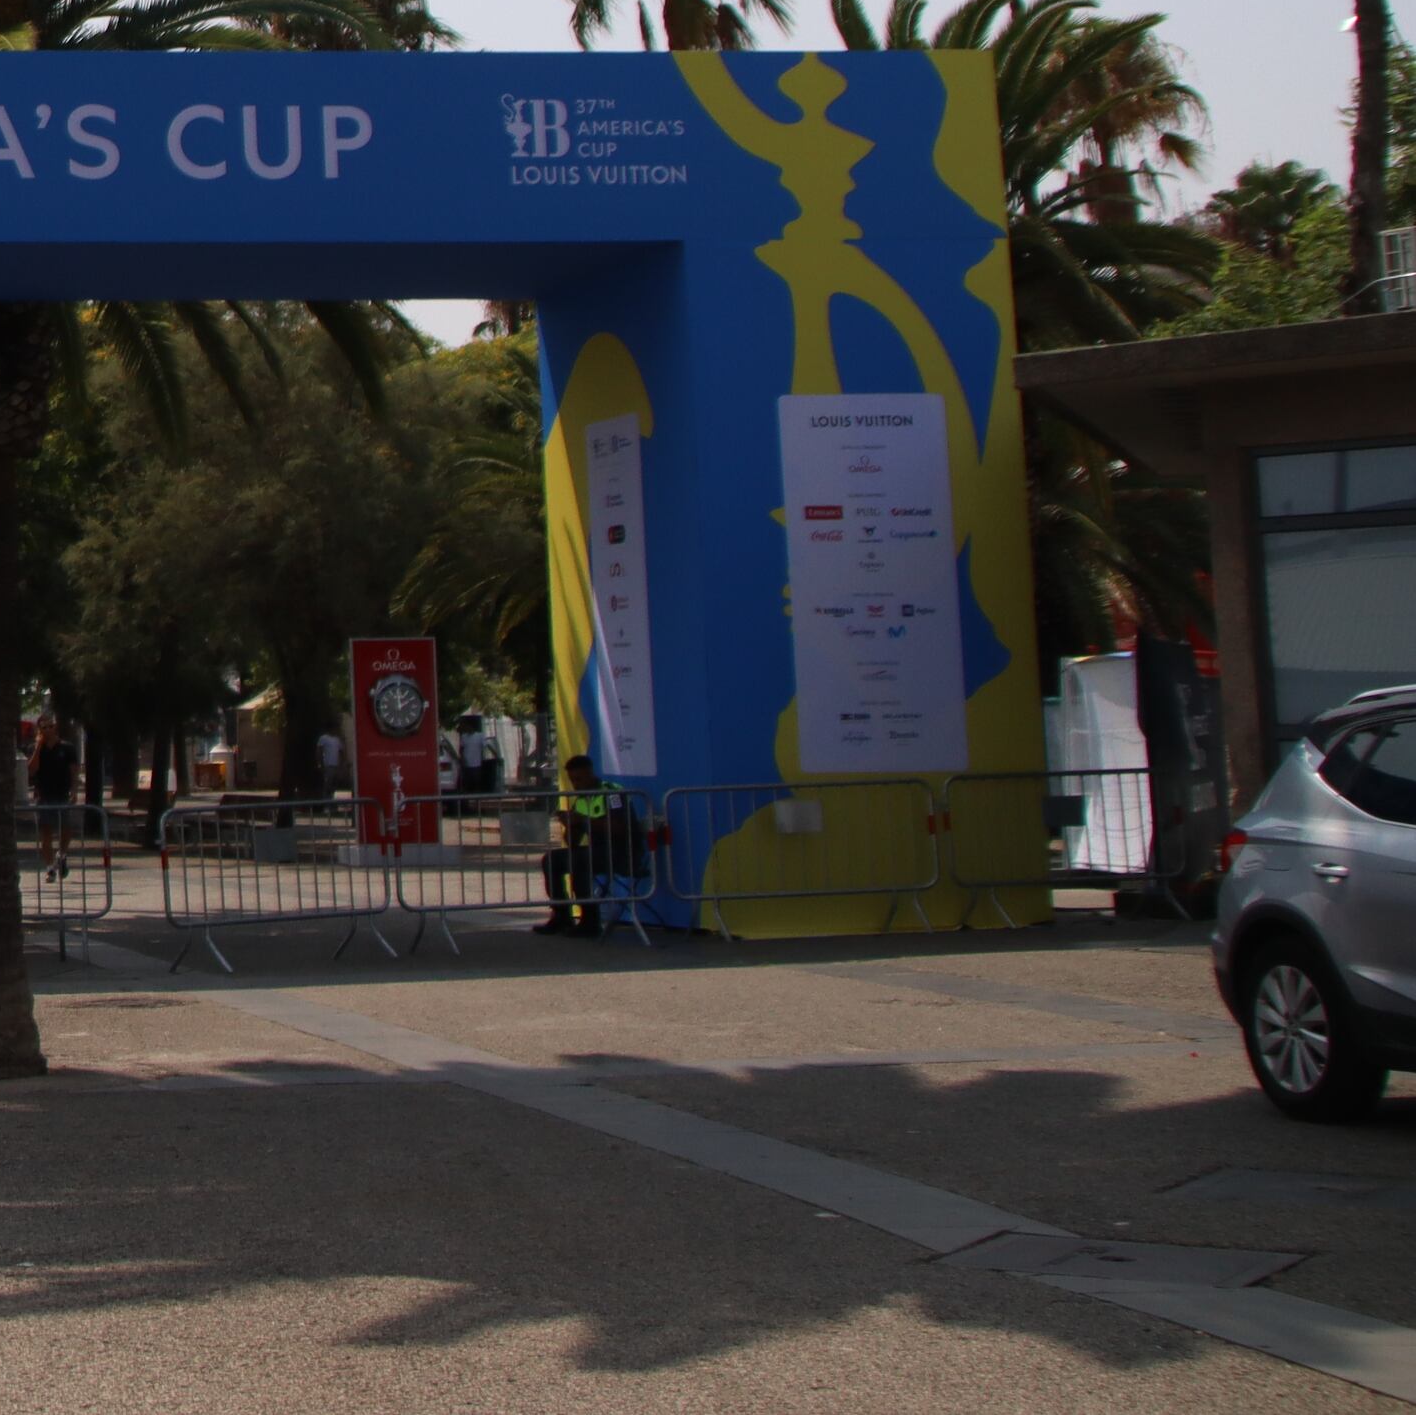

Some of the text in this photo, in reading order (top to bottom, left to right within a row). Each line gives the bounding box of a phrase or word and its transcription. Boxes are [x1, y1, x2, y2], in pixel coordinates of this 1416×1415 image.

[575, 99, 616, 115] 37TH
[576, 120, 685, 136] AMERICA'S
[168, 103, 372, 180] CUP
[577, 142, 618, 158] CUP
[511, 165, 687, 185] LOUIS VUITTON
[811, 415, 913, 428] LOUIS VUITTON
[372, 661, 416, 671] OMEGA
